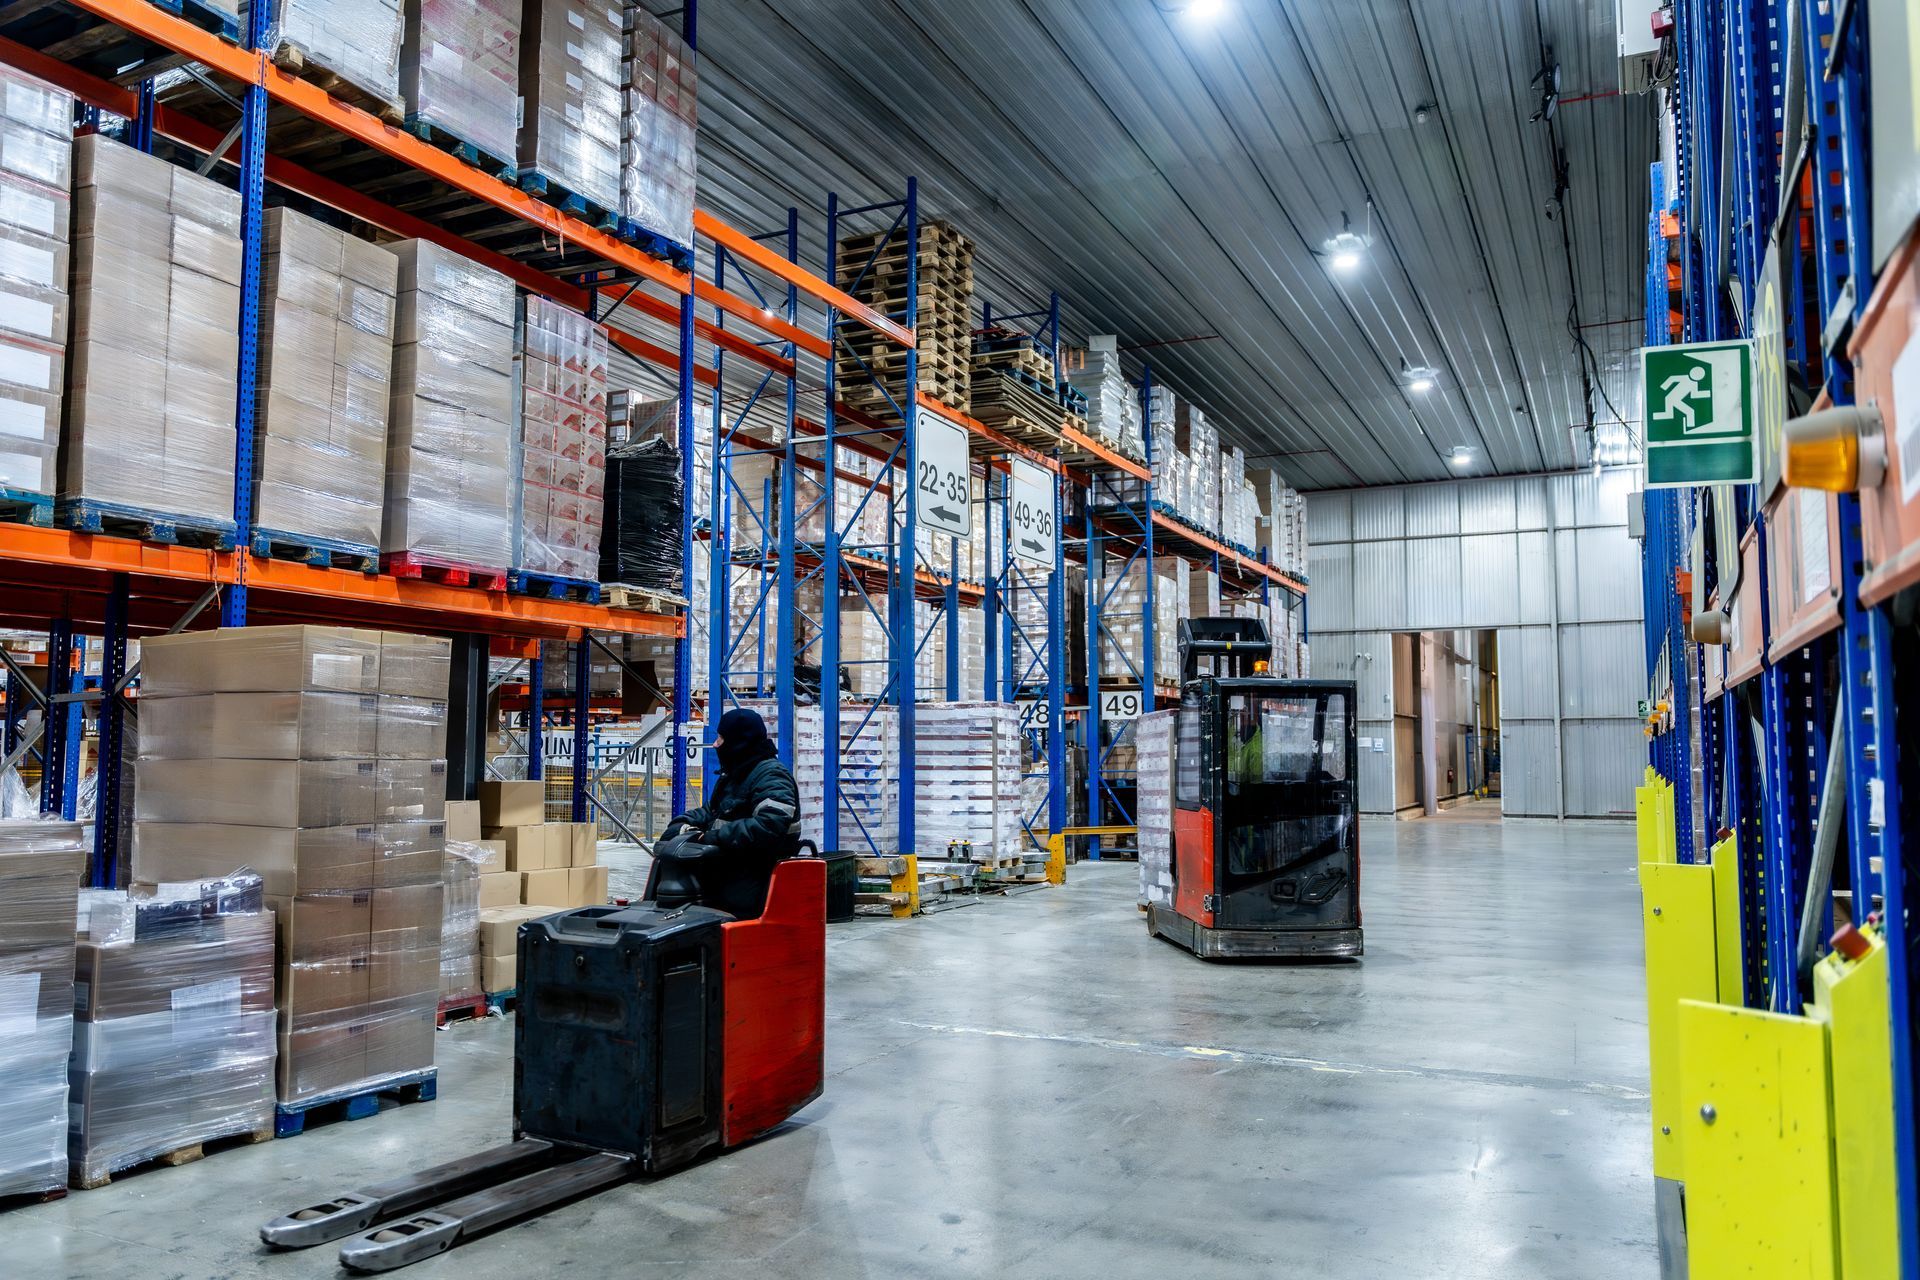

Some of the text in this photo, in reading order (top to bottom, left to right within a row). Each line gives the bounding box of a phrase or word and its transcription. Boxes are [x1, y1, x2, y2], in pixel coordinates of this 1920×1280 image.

[1759, 281, 1782, 470] 18
[919, 460, 967, 505] 22-35
[1014, 500, 1052, 538] 49-36
[1020, 704, 1049, 724] 48
[1105, 695, 1138, 716] 49
[540, 736, 596, 762] UNO
